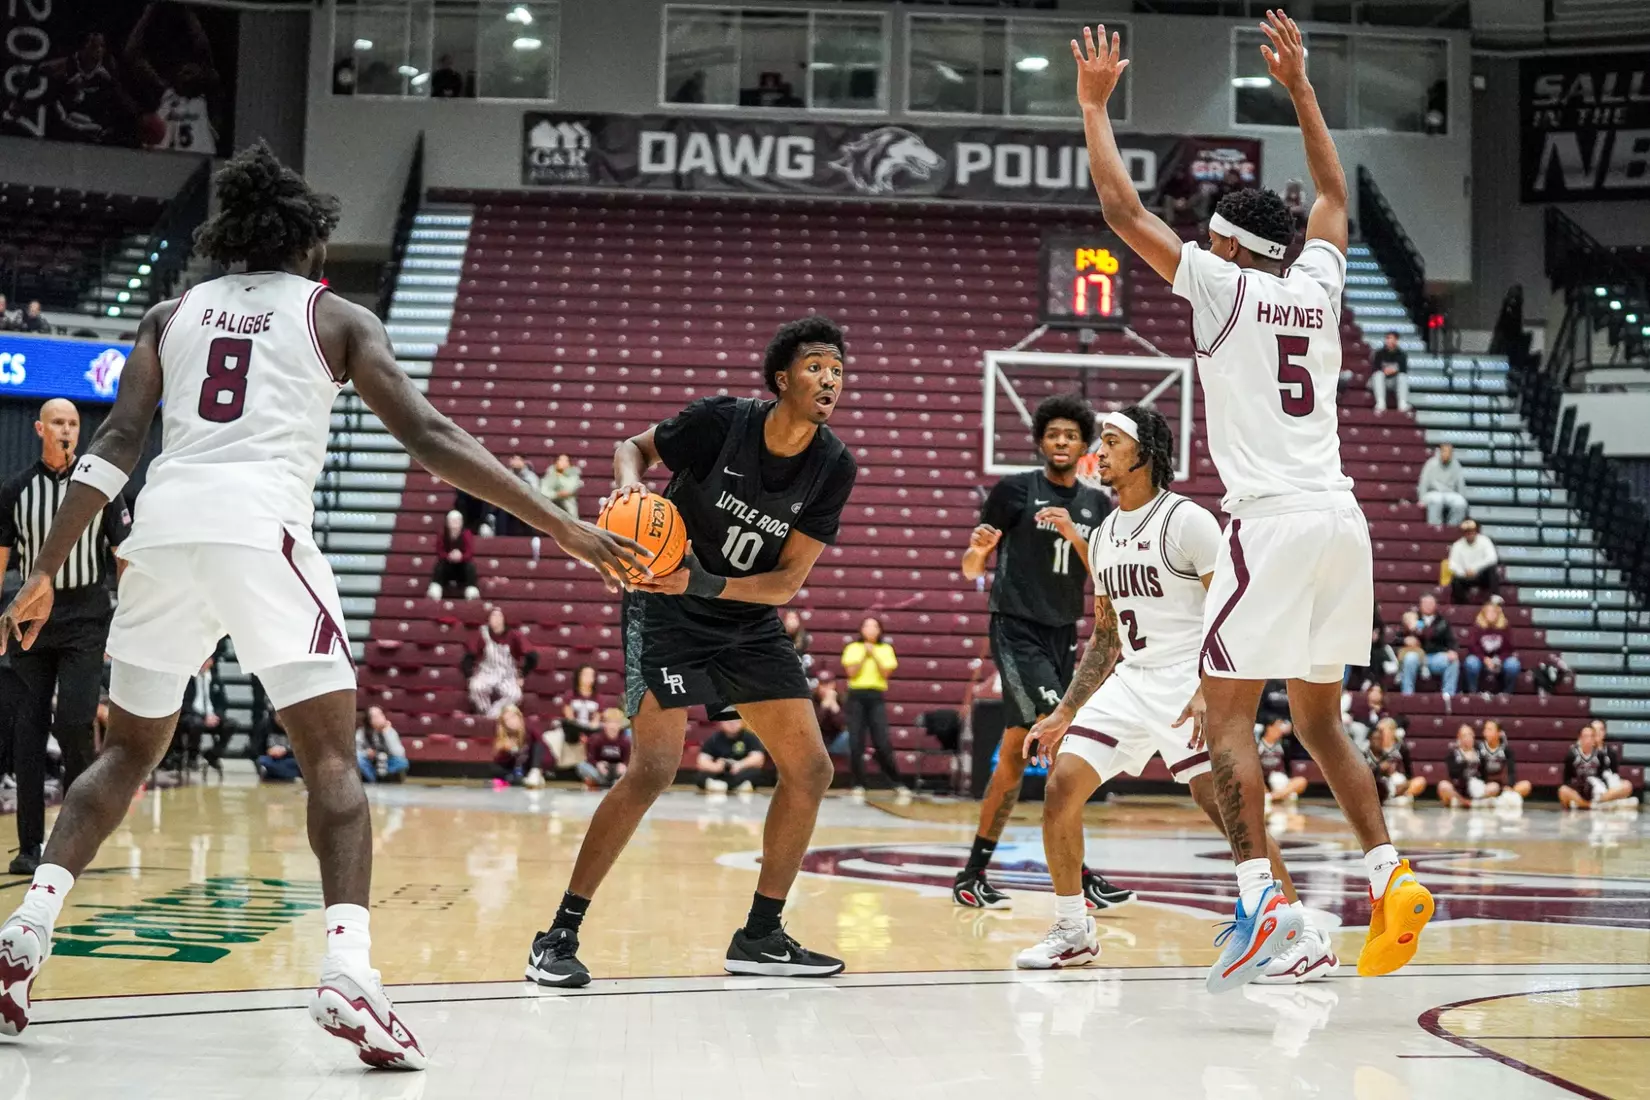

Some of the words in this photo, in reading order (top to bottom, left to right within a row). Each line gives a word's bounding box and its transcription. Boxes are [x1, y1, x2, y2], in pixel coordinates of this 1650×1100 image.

[637, 130, 816, 179] DAWG
[1074, 272, 1112, 316] 17
[202, 309, 214, 326] P.
[215, 312, 274, 334] ALIGBE
[1257, 301, 1323, 329] HAYNES
[198, 337, 253, 424] 8
[1275, 334, 1315, 417] 5
[649, 500, 665, 538] NCAA
[715, 490, 760, 525] LITTLE
[721, 525, 764, 571] 10
[1053, 538, 1072, 575] 11
[1098, 563, 1164, 600] LUKIS
[1119, 609, 1147, 651] 2
[660, 667, 687, 695] LR
